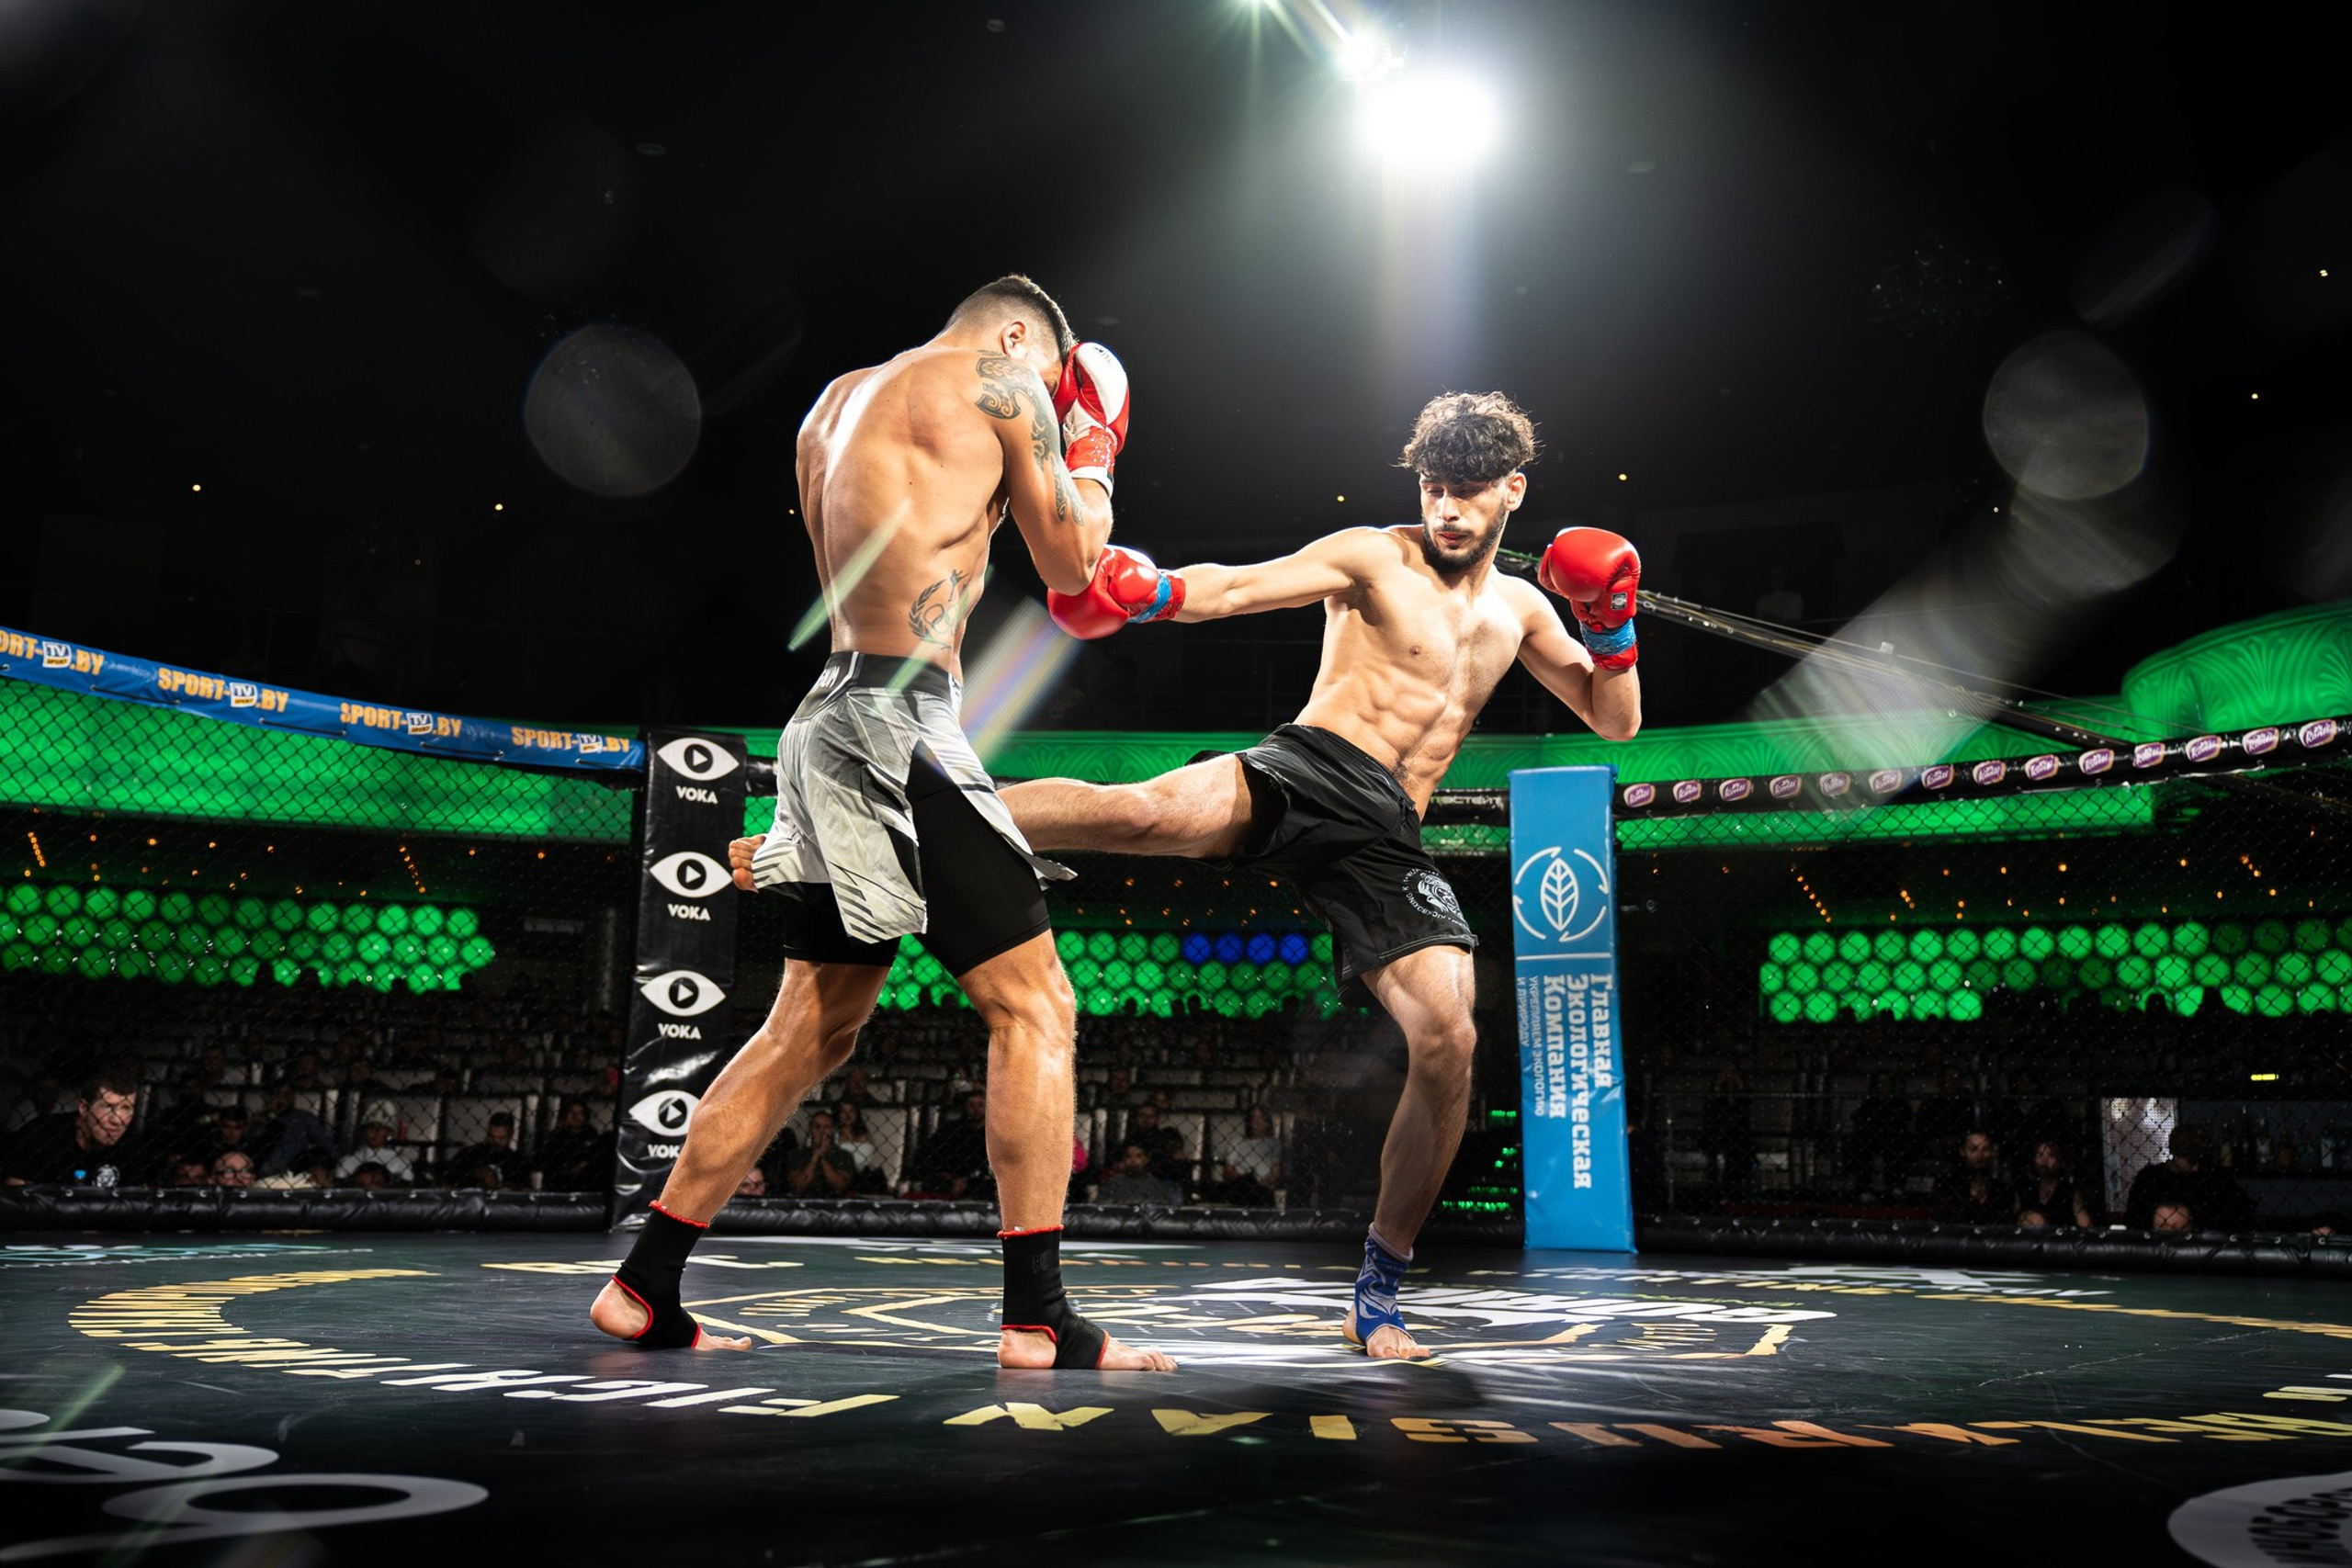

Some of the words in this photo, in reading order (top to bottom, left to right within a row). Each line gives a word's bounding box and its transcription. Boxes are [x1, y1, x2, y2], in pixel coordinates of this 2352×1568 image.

[675, 785, 718, 804] VOKA
[667, 903, 711, 921] VOKA
[1406, 893, 1447, 919] KICKBOXING
[657, 1022, 702, 1040] VOKA
[1590, 973, 1613, 1089] Главная
[1544, 975, 1566, 1119] Компания
[1532, 1050, 1545, 1117] ЭКОЛОГИЮ
[1566, 974, 1592, 1190] Экологическая
[647, 1144, 682, 1158] VOK
[845, 1246, 1140, 1258] VOA
[119, 1339, 901, 1417] FIGHTING
